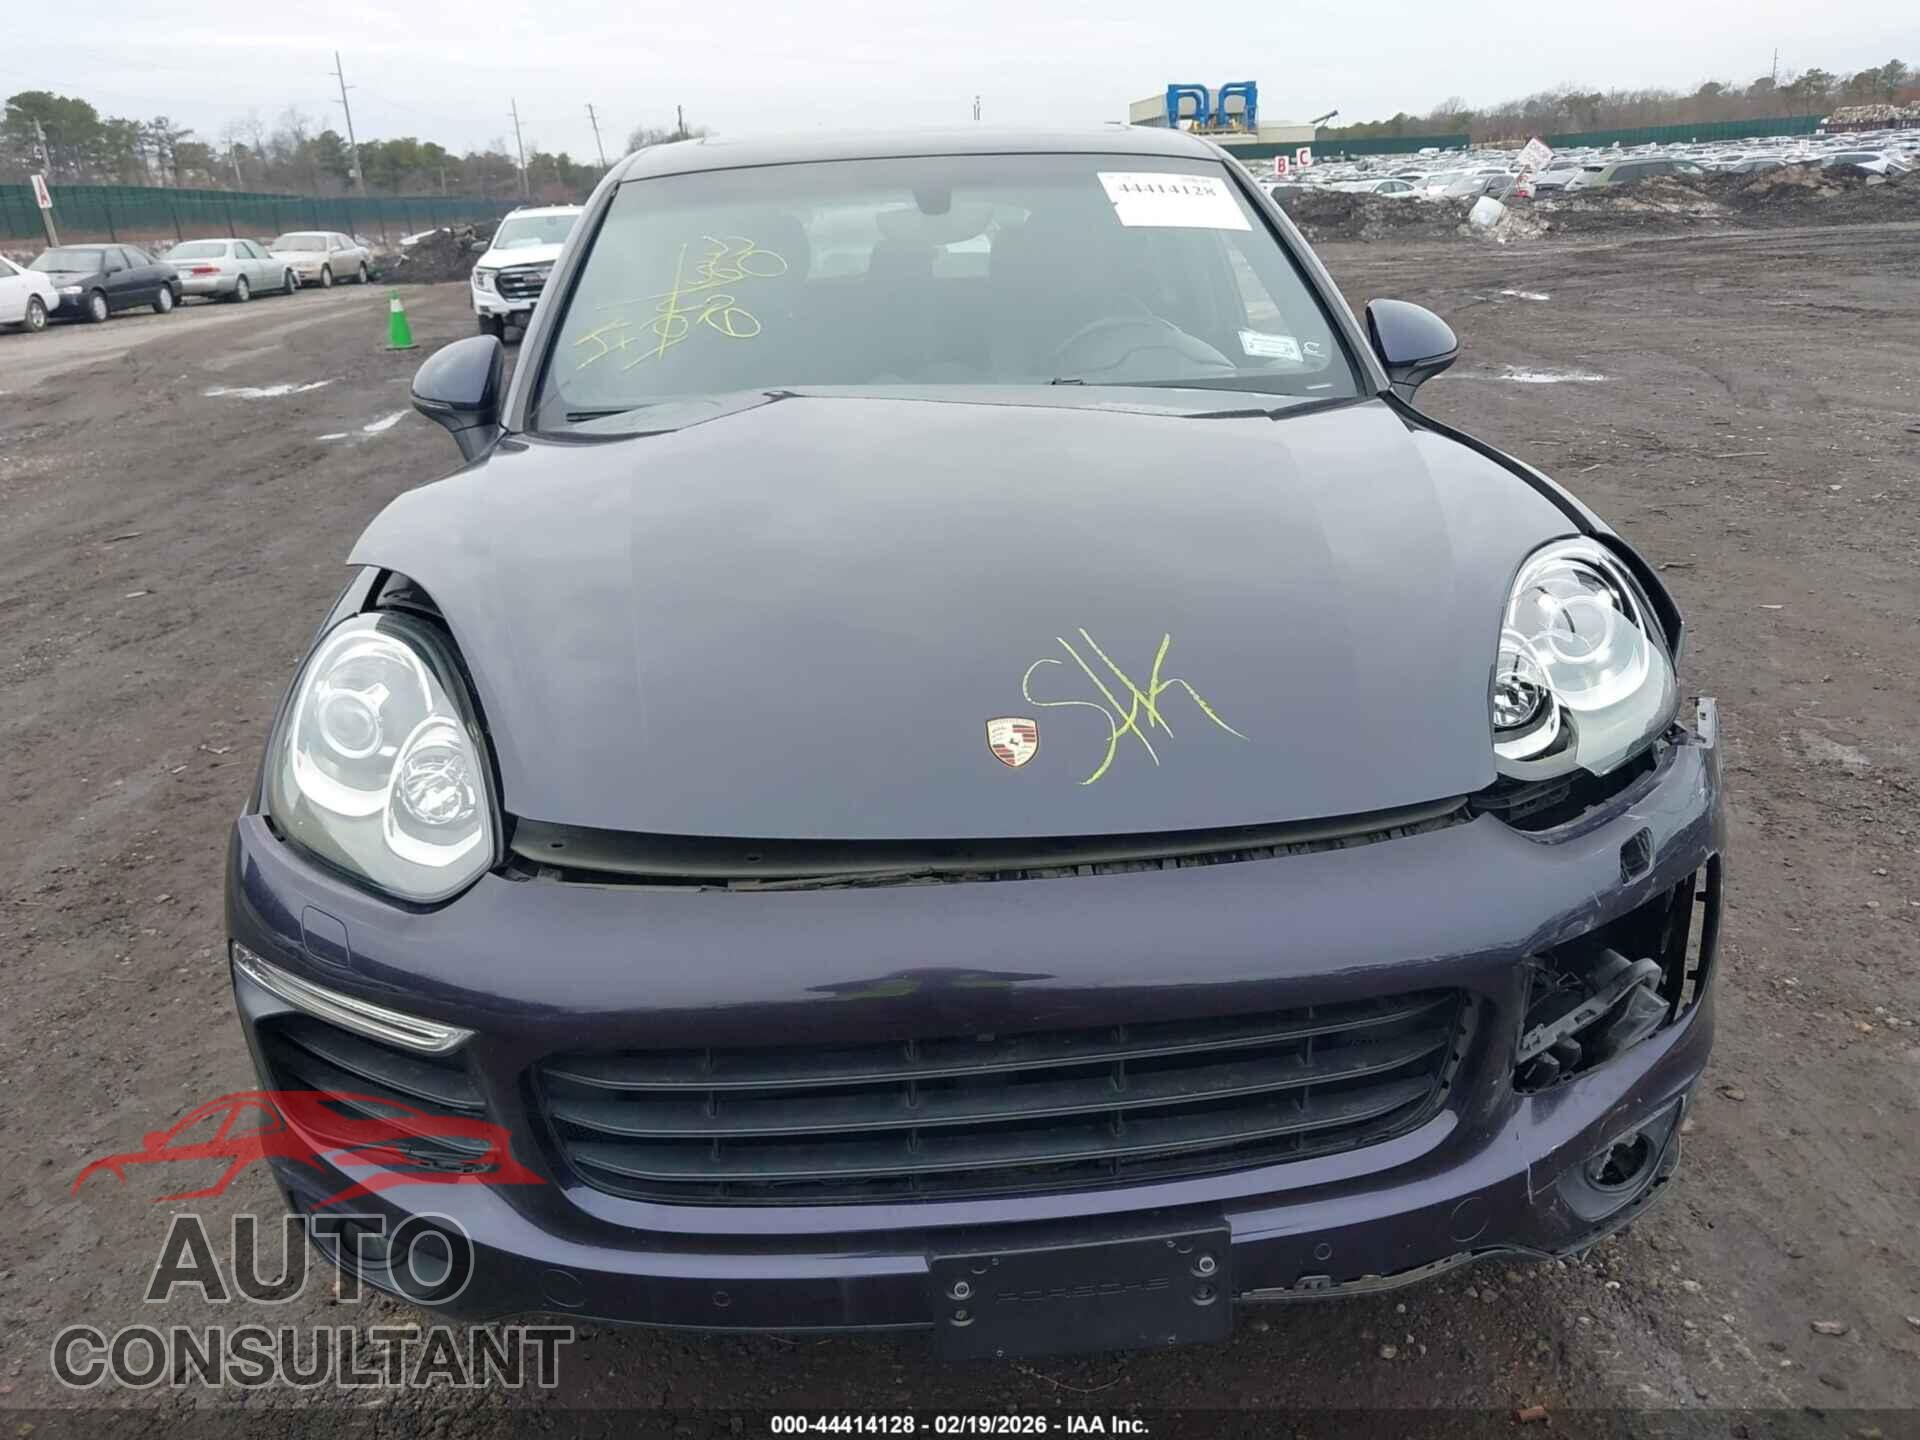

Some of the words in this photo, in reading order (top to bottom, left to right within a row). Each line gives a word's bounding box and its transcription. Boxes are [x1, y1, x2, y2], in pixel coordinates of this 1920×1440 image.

[1300, 150, 1308, 165] C
[1278, 158, 1286, 173] B
[37, 176, 49, 205] A
